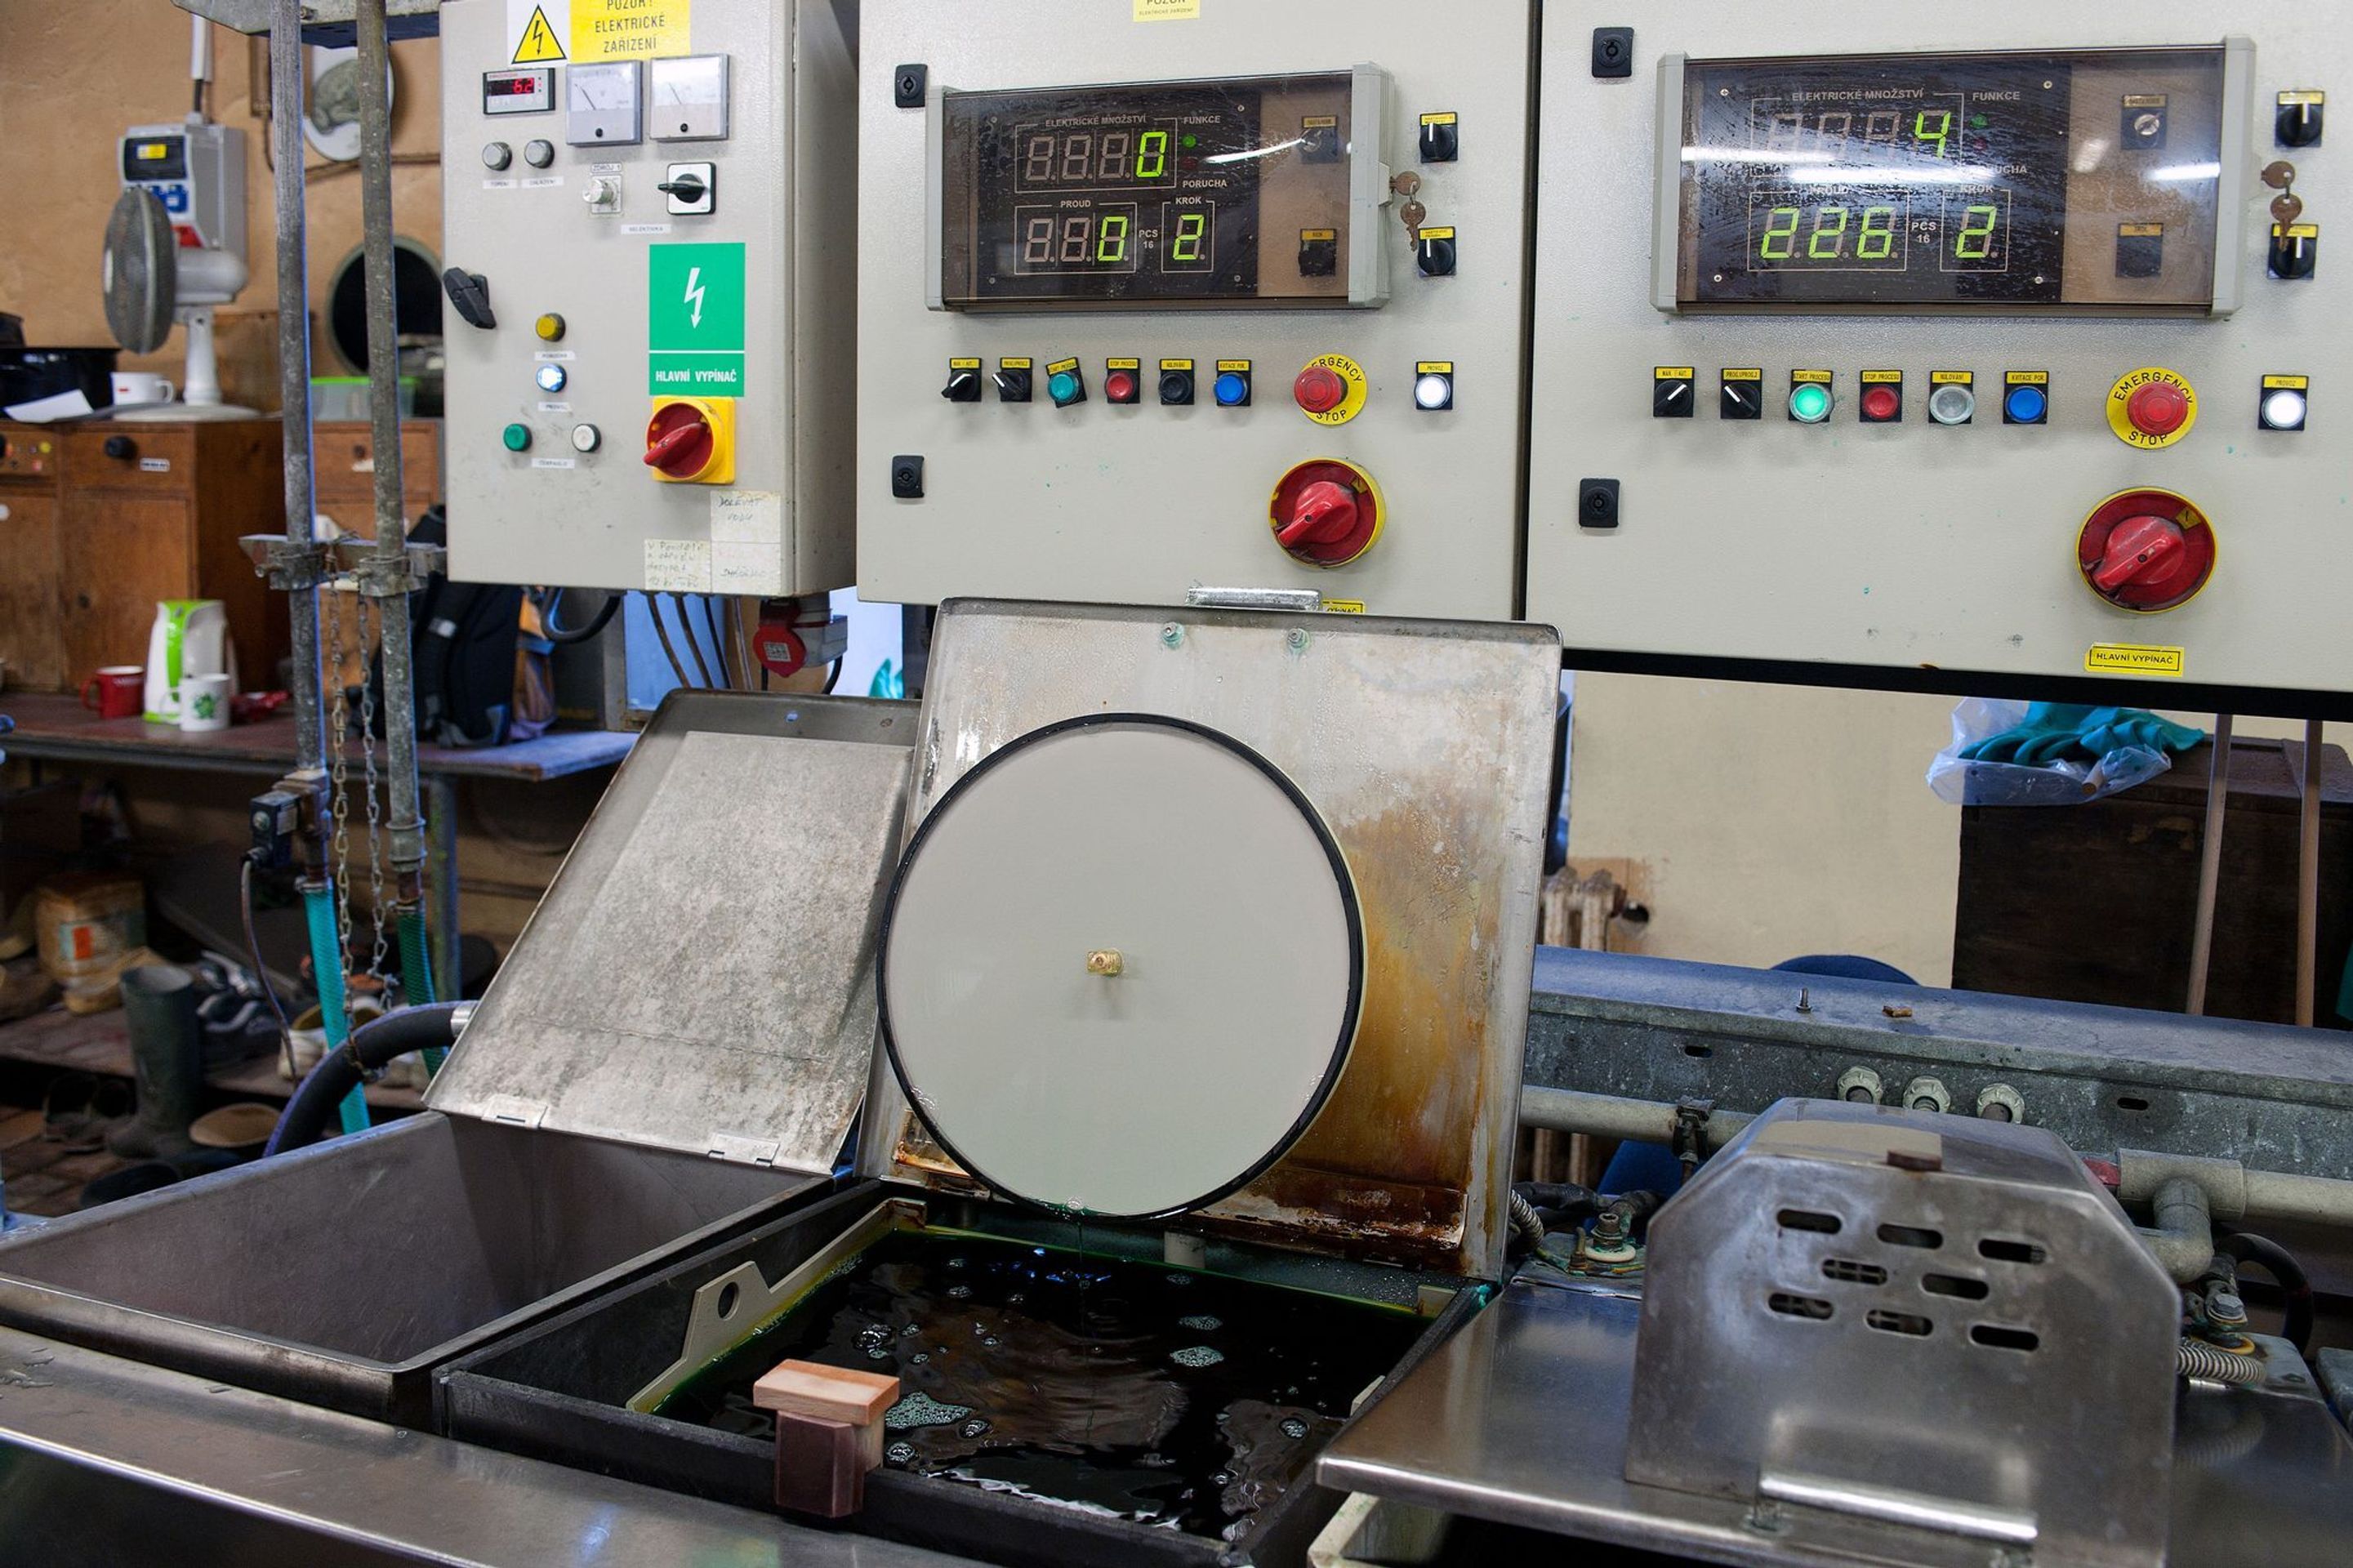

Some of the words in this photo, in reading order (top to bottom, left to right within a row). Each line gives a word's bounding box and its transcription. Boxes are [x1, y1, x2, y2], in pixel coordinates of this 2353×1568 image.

[595, 12, 666, 33] ELEKTRICKÉ
[603, 34, 657, 53] ZAŘÍZENÍ
[1791, 90, 1862, 101] ELEKTRICKÉ
[1865, 87, 1924, 100] MNOŽSTVÍ
[1972, 91, 2021, 101] FUNKCE
[1045, 117, 1099, 127] ELEKTRICKÉ
[1101, 114, 1147, 125] MNOŽSTVÍ
[1183, 115, 1221, 125] FUNKCE
[1914, 111, 1952, 159] 4
[1136, 131, 1168, 178] 0
[1182, 179, 1228, 189] PORUCHA
[1961, 184, 1994, 194] KROK
[1060, 199, 1091, 208] PROUD
[1174, 196, 1202, 205] KROK
[1760, 207, 1896, 259] 226
[1911, 221, 1936, 231] PCS
[1955, 206, 1997, 259] 2
[1097, 216, 1129, 261] 0
[1139, 229, 1158, 238] PCS
[1172, 214, 1205, 261] 2
[1917, 234, 1931, 243] 16
[1143, 240, 1154, 249] 16
[656, 368, 691, 382] HLAVNÍ
[695, 368, 737, 383] VYPÍNAČ
[2114, 372, 2194, 404] EMERGENCY
[1316, 409, 1347, 421] STOP
[2128, 430, 2168, 445] STOP
[2096, 653, 2130, 661] HLAVNÍ
[2132, 654, 2173, 664] VYPÍNAČ
